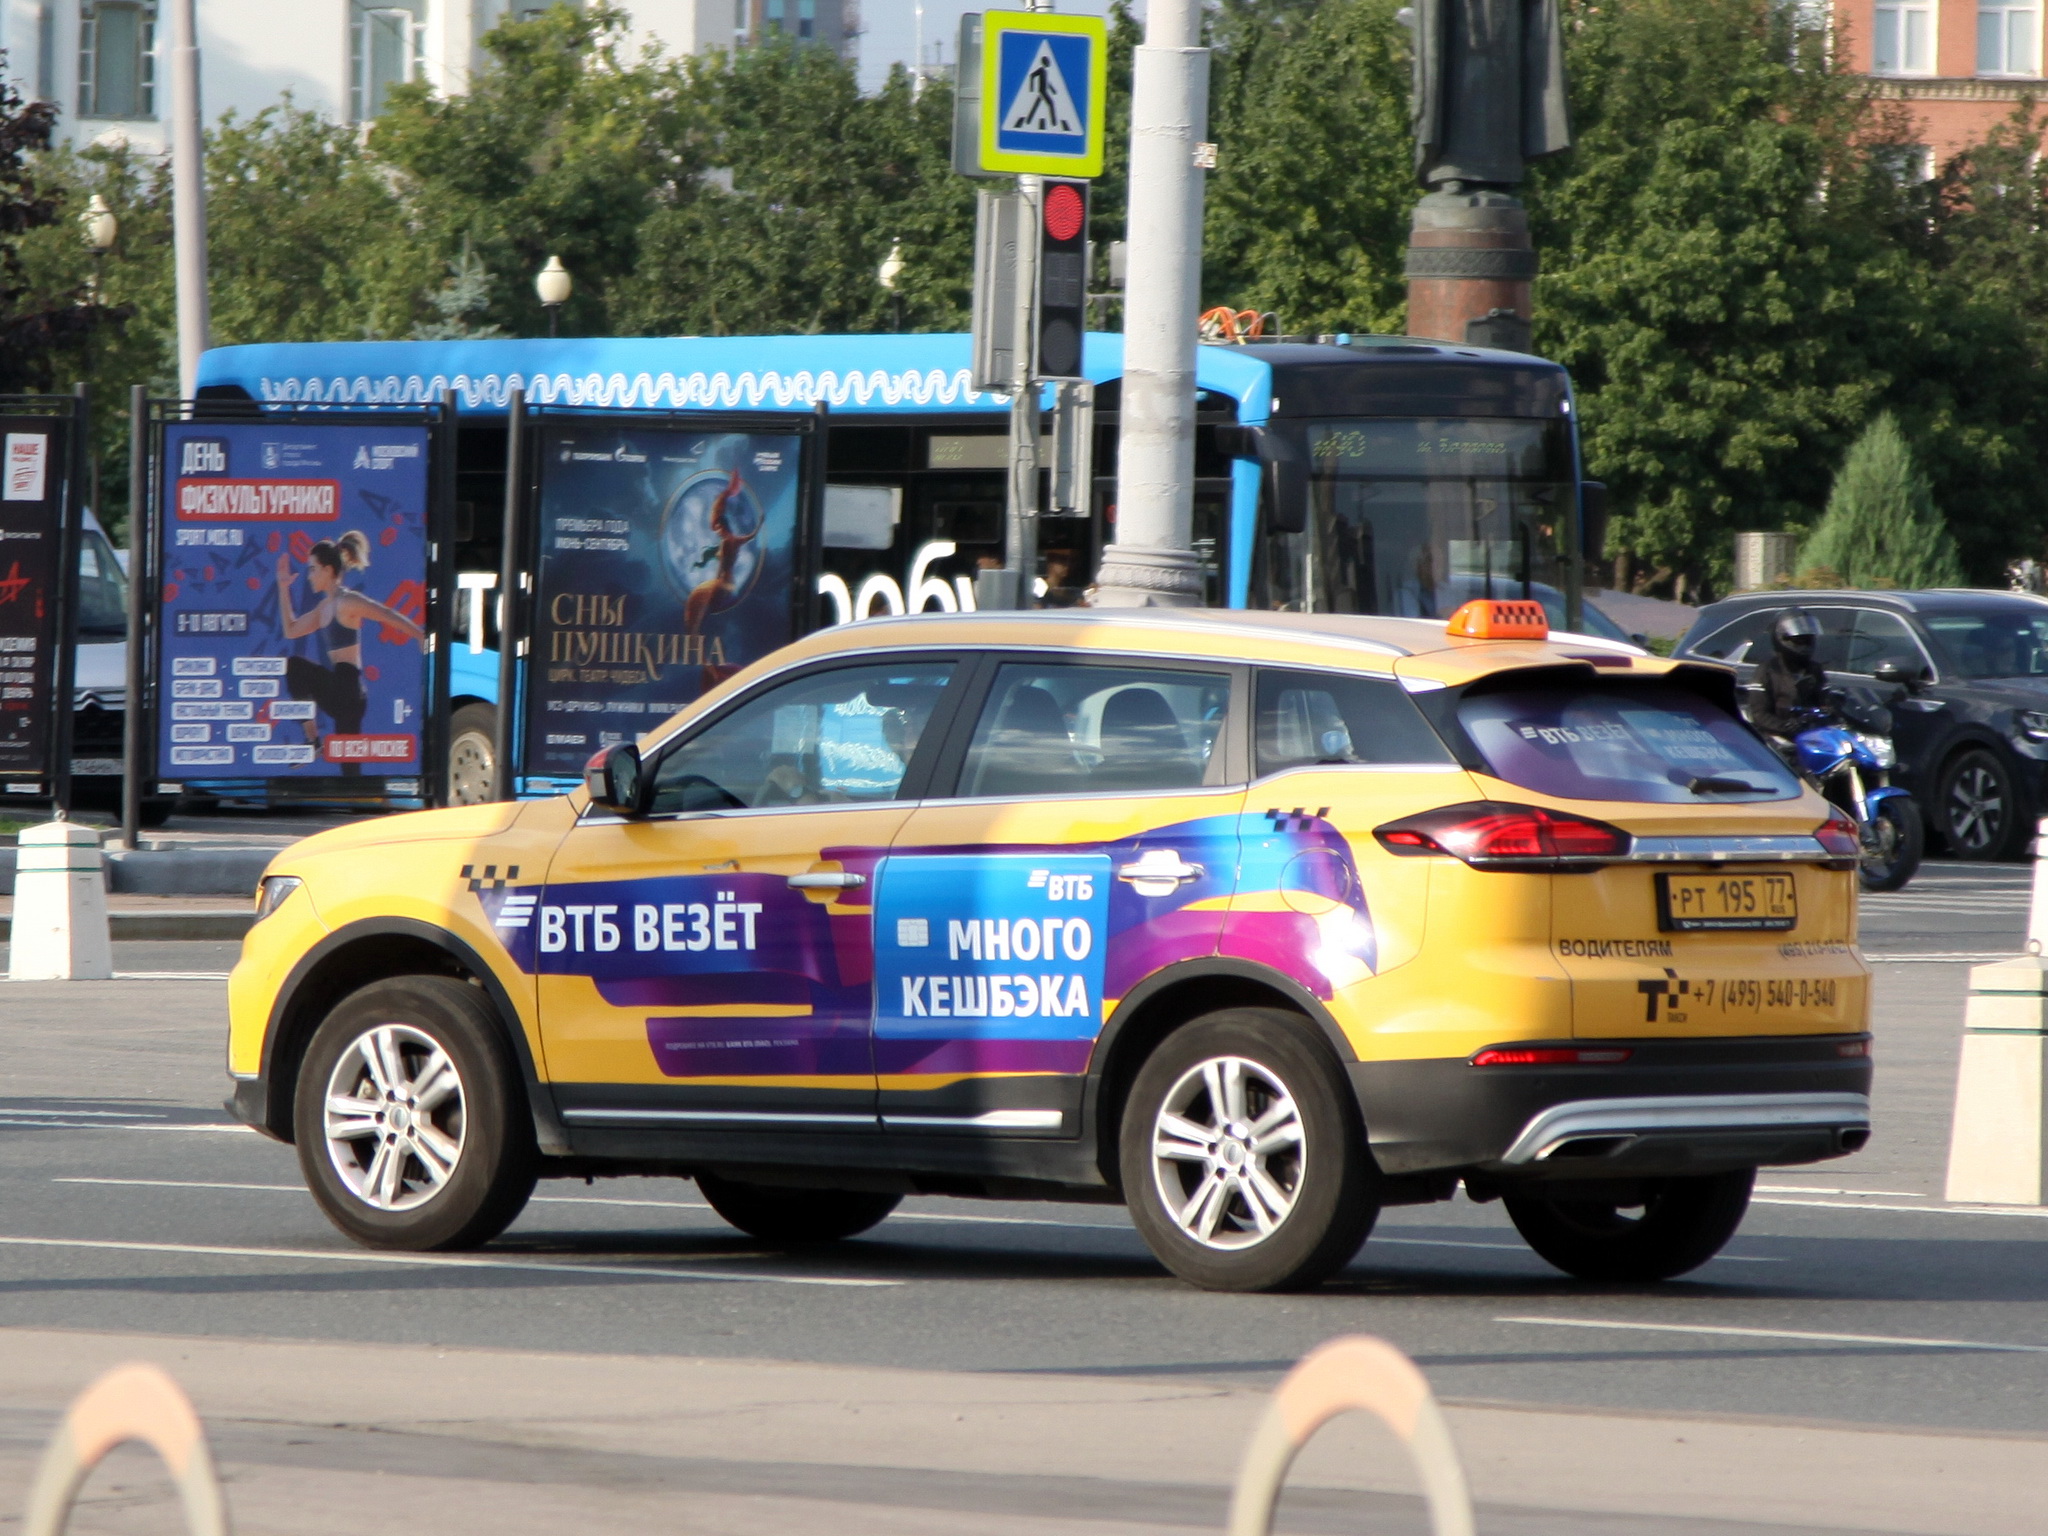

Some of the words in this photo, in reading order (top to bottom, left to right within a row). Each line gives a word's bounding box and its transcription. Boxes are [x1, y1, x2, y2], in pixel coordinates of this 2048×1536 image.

[181, 442, 226, 475] ДЕНЬ
[181, 485, 335, 514] ФИЗКУЛЬТУРНИКА
[201, 613, 247, 631] АВГУСТА
[551, 593, 627, 626] СНЫ
[551, 631, 727, 681] ПУШКИНА
[344, 738, 369, 758] ВСЕЙ
[370, 740, 409, 758] МОСКВЕ
[1538, 727, 1580, 744] ВТБ
[1048, 874, 1094, 901] ВТБ
[1680, 888, 1705, 913] РТ
[1717, 880, 1756, 913] 195
[1766, 878, 1785, 904] 77
[540, 905, 621, 952] ВТБ
[634, 891, 763, 951] ВЕЗЁТ
[948, 919, 1092, 961] МНОГО
[1560, 939, 1673, 959] ВОДИТЕЛЯМ
[902, 975, 1090, 1017] КЕШБЭКА
[1694, 980, 1715, 1006] +7
[1722, 979, 1761, 1013] (495)
[1767, 979, 1836, 1007] 540-0-540
